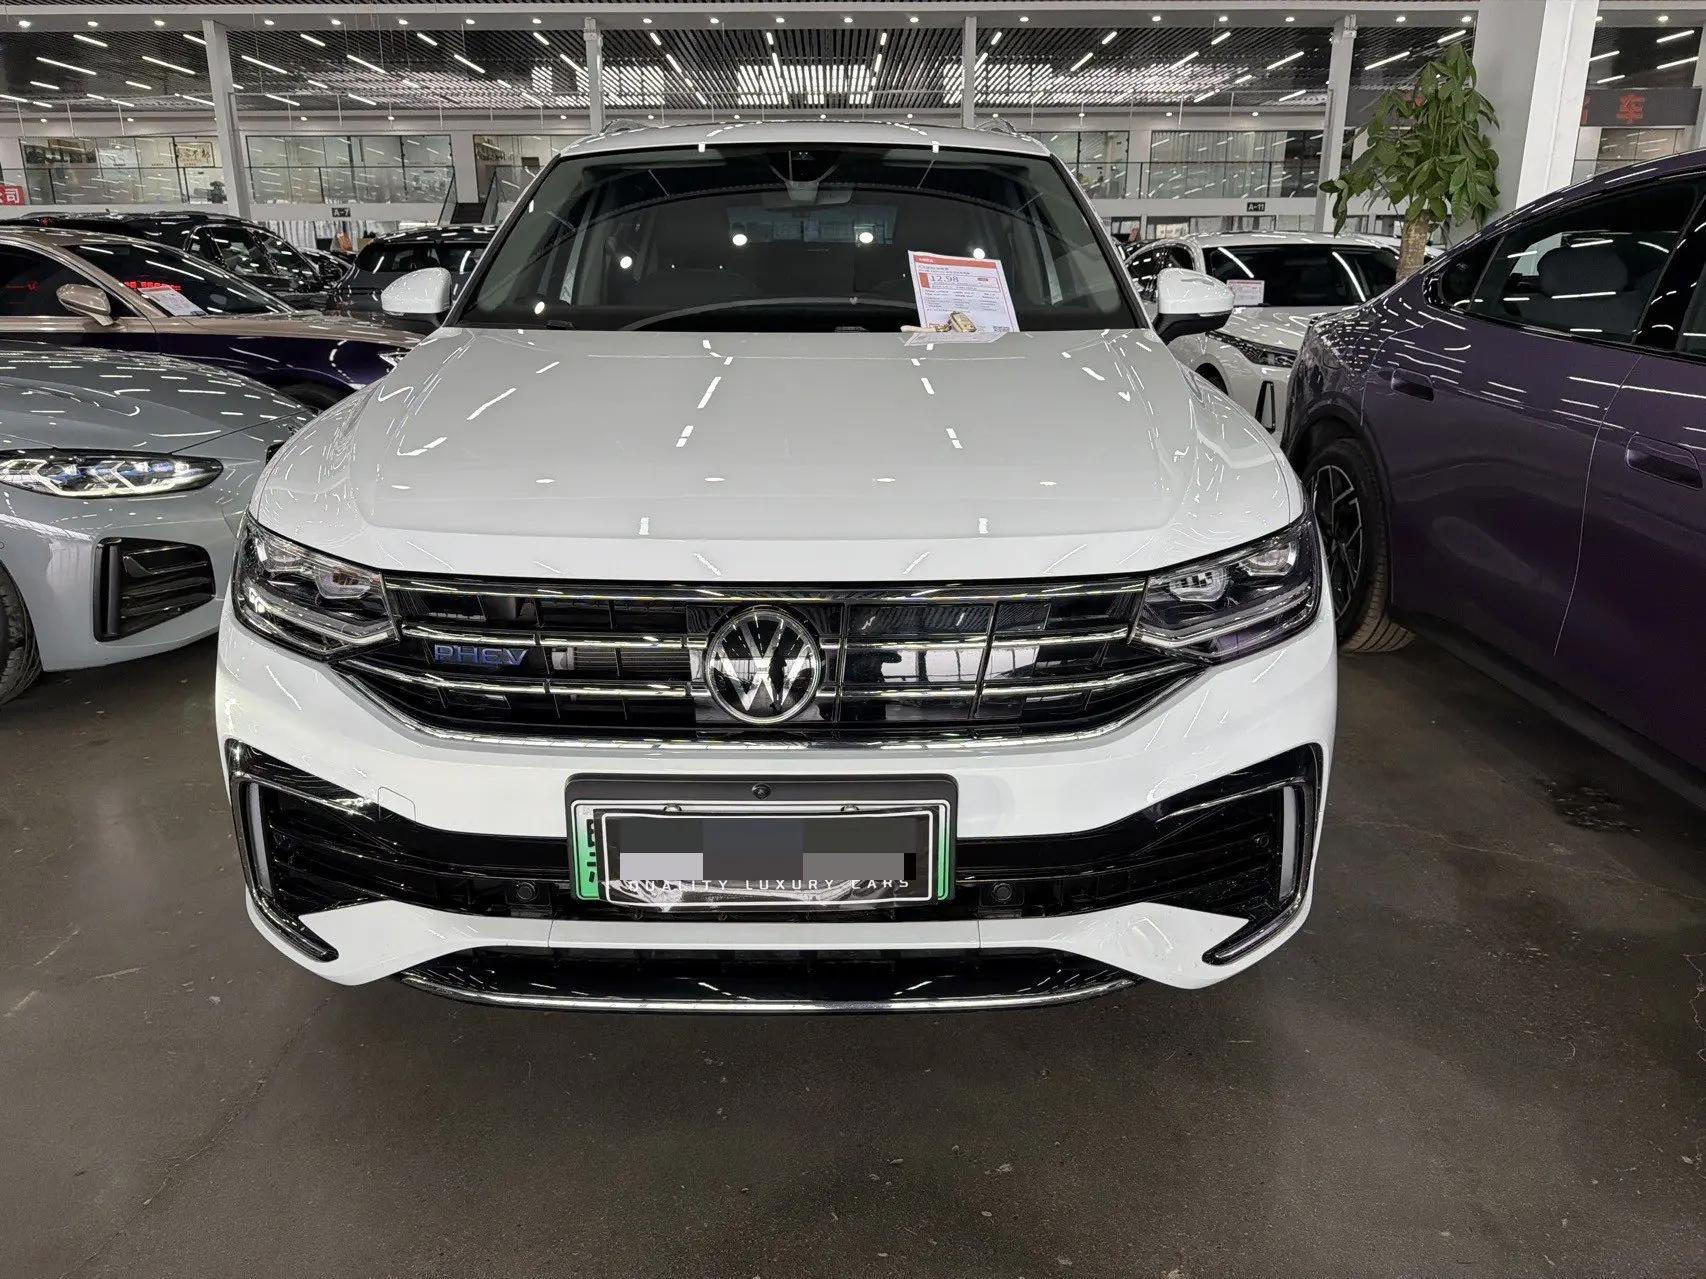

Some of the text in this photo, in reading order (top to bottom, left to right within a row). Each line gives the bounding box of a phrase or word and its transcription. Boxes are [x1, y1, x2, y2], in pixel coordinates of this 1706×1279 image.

[0, 188, 20, 204] 司
[333, 208, 350, 216] A-7
[1248, 203, 1265, 211] A-11
[930, 275, 960, 283] 12.98
[433, 644, 529, 666] PHEV
[628, 879, 909, 892] QUALITY LUXURY CARS
